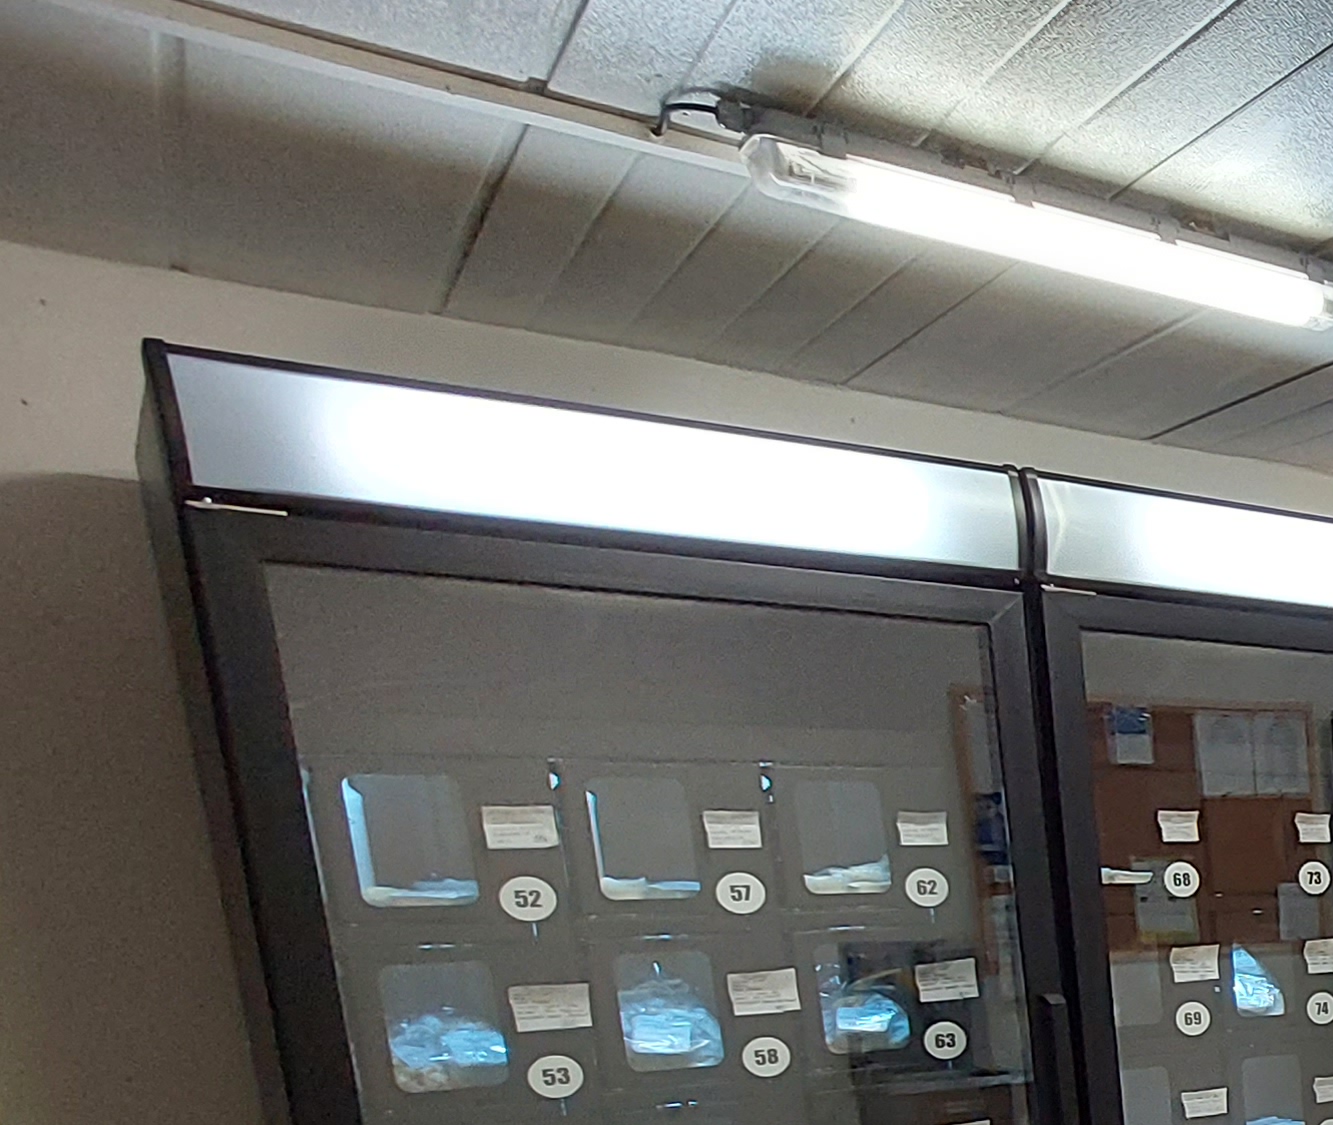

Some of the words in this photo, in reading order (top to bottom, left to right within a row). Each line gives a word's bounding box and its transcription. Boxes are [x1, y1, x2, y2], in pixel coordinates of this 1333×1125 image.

[1173, 872, 1191, 887] 68
[1306, 871, 1322, 885] 73
[729, 884, 751, 902] 57
[916, 879, 938, 896] 62
[513, 889, 543, 908] 52
[1315, 1001, 1329, 1016] 74
[1184, 1011, 1202, 1026] 69
[934, 1032, 956, 1049] 63
[754, 1048, 779, 1066] 58
[541, 1067, 571, 1086] 53
